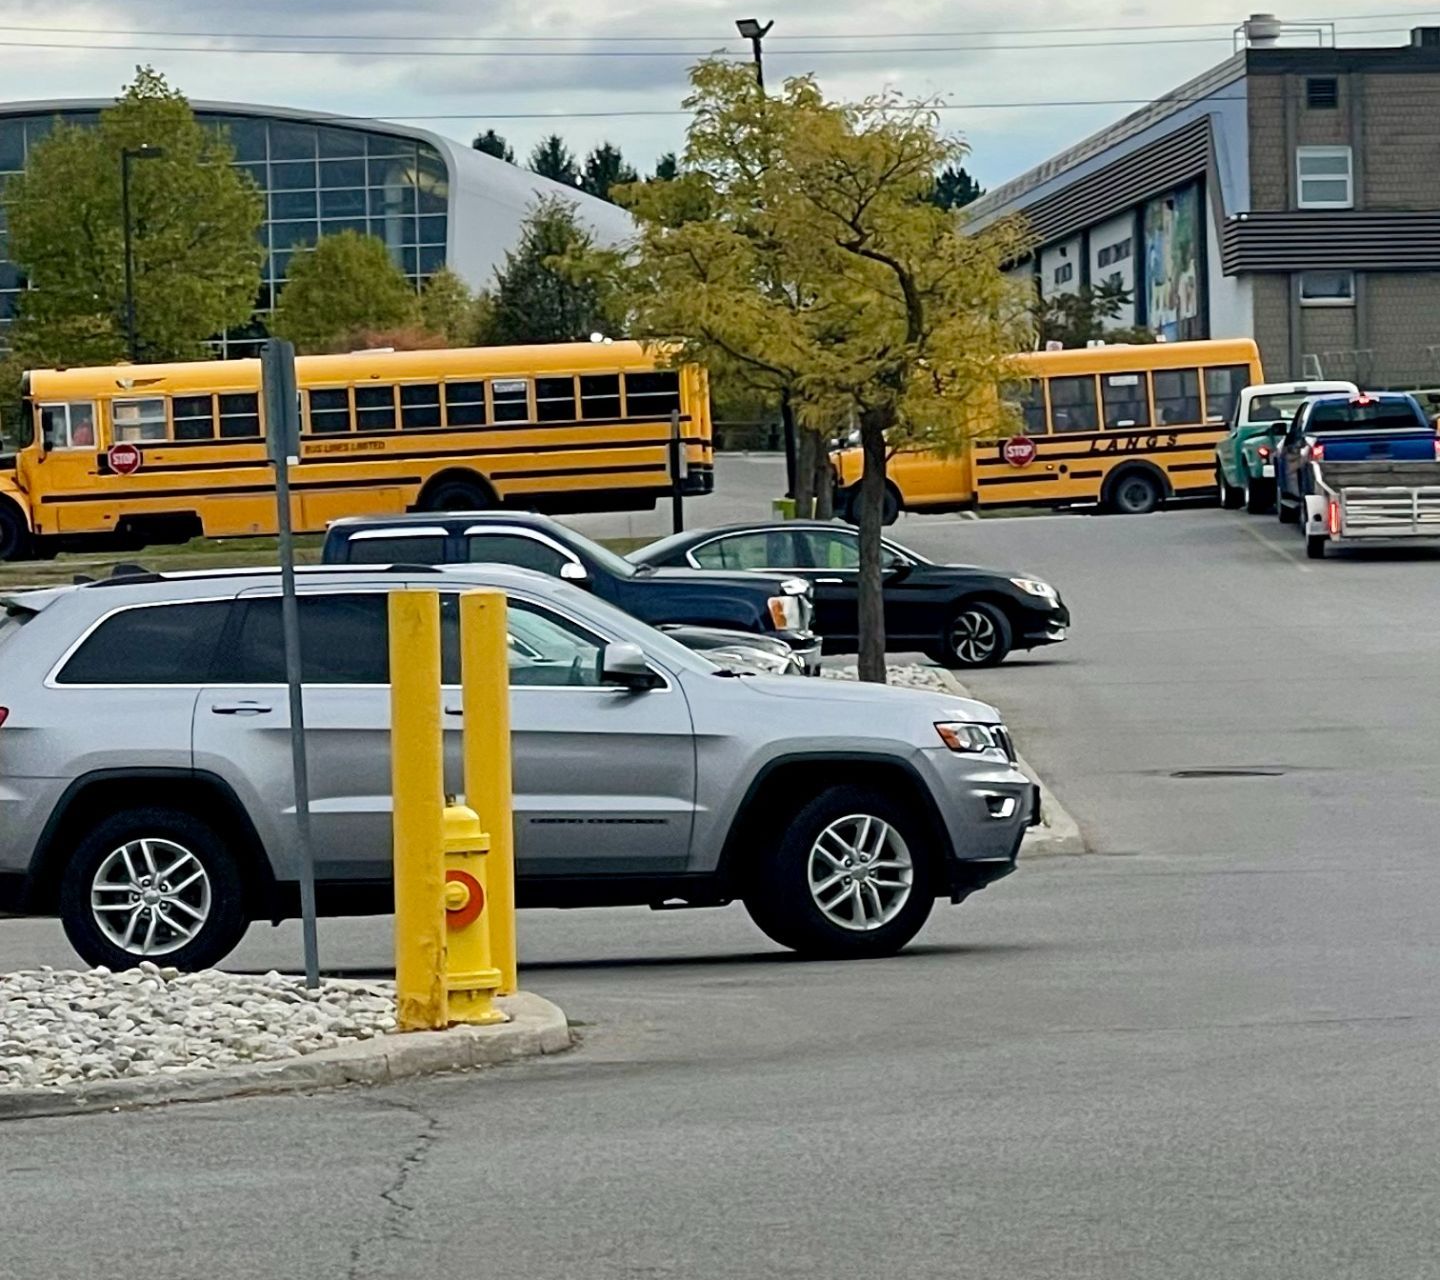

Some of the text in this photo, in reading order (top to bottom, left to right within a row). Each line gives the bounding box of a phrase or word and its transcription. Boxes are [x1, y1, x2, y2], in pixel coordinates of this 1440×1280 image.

[351, 440, 385, 450] LIMITED
[1089, 433, 1179, 452] LANGS
[1007, 446, 1033, 458] STOP
[112, 452, 136, 465] STOP
